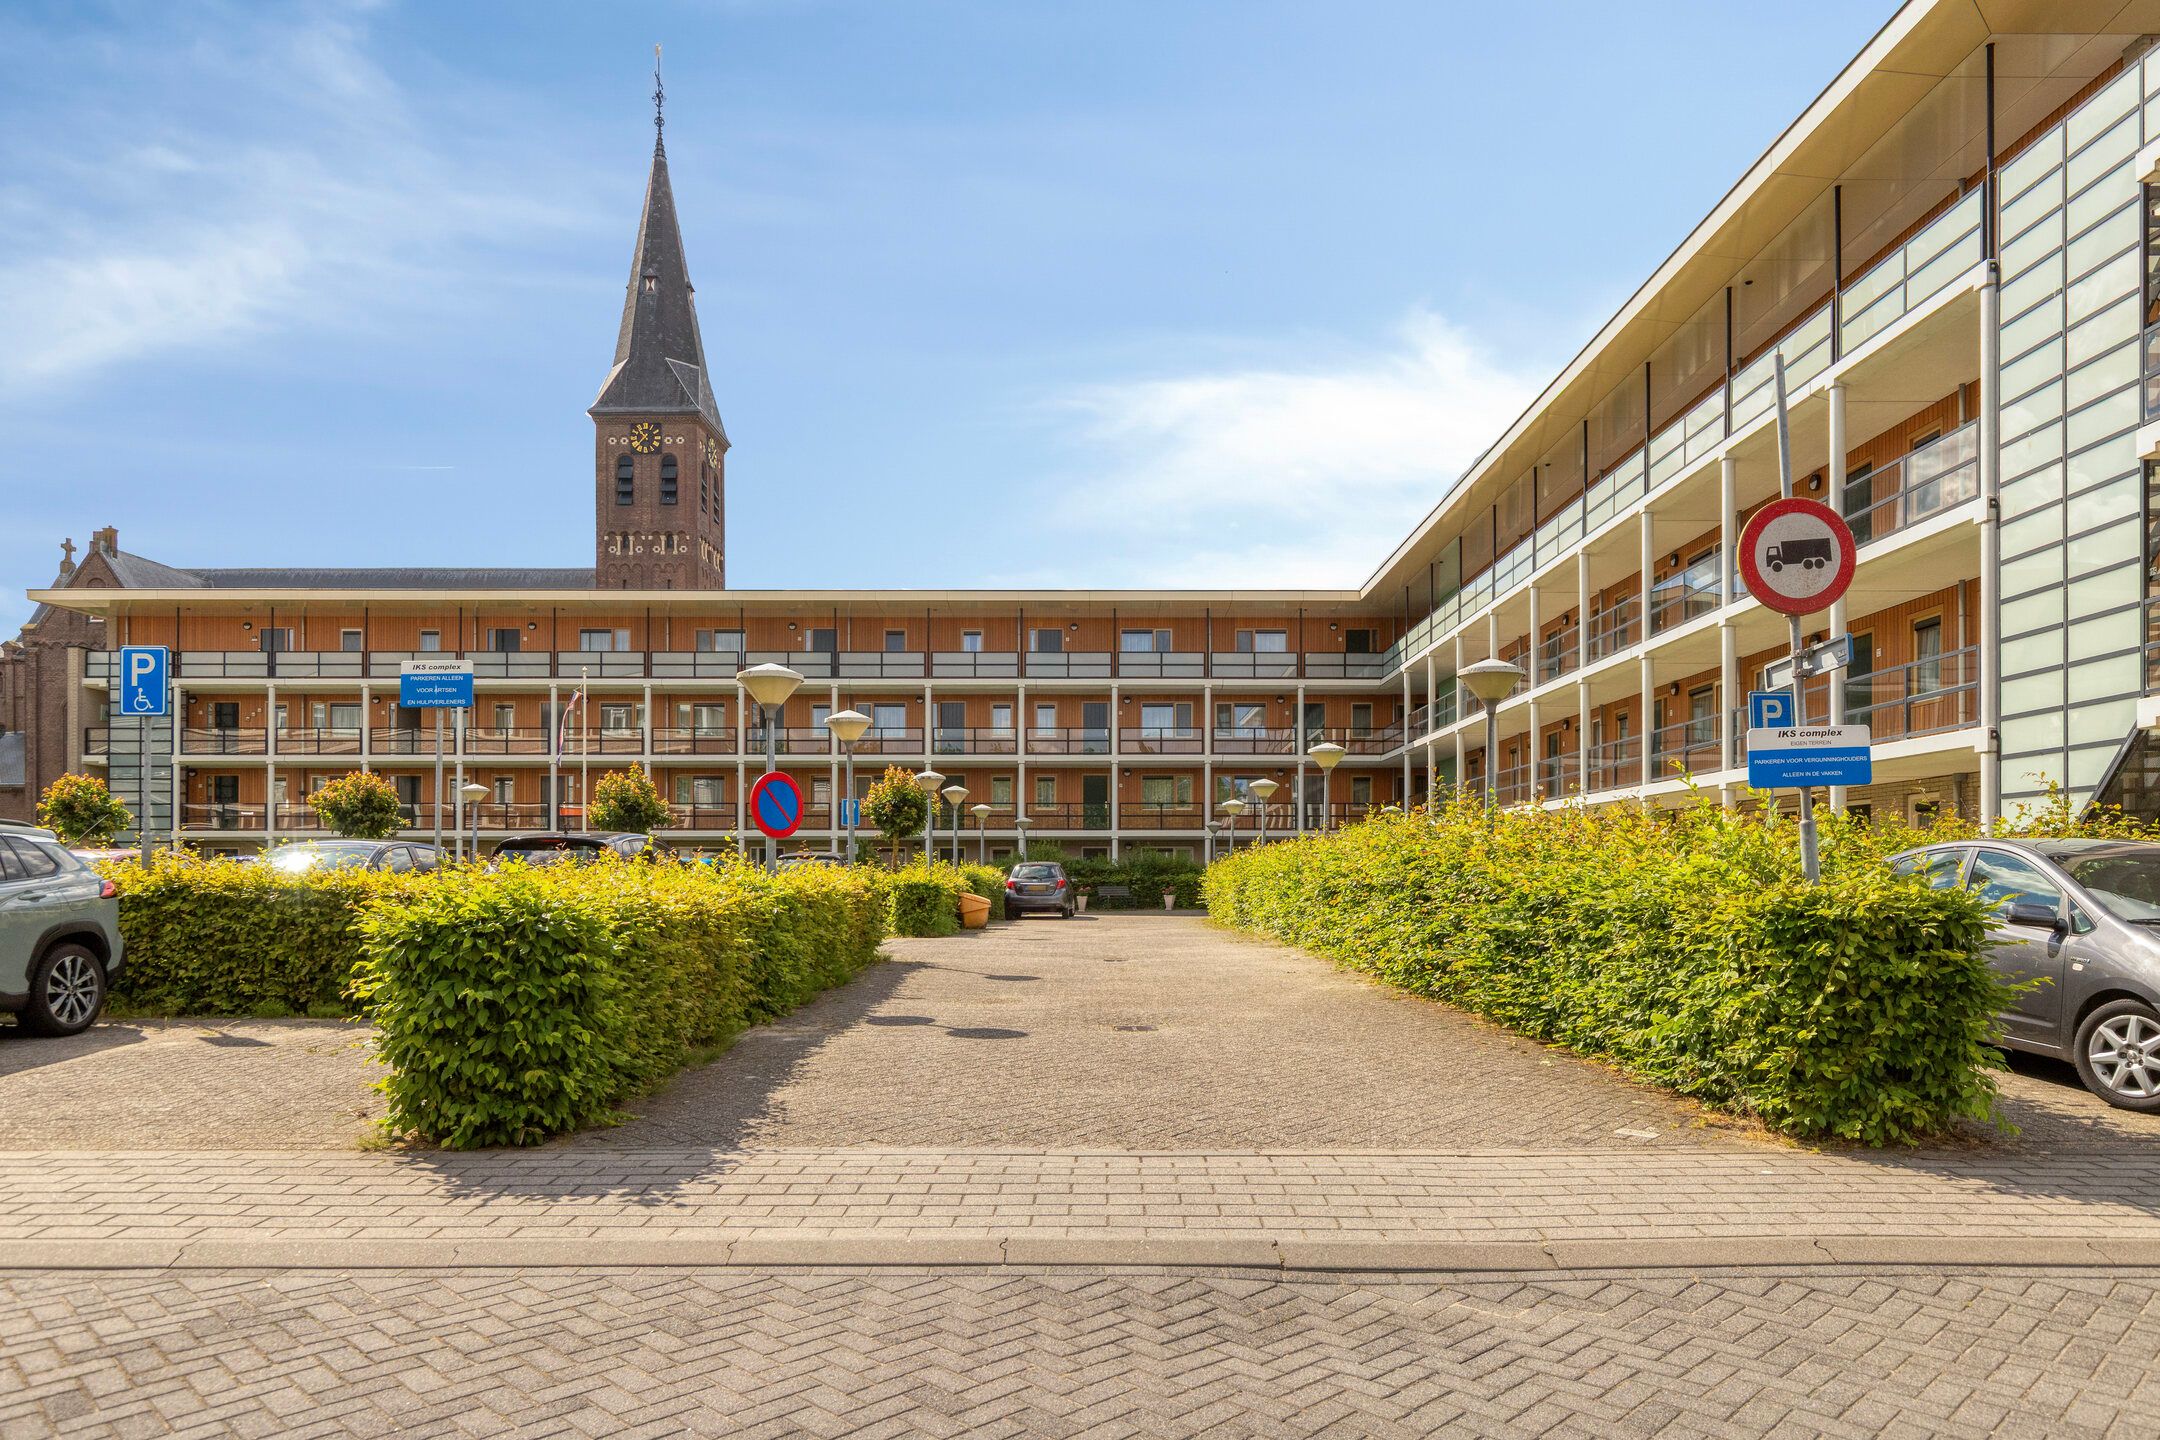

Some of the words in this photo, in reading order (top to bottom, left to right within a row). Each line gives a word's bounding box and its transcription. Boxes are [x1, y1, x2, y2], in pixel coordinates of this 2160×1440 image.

[131, 653, 156, 687] P
[1761, 699, 1783, 728] P
[1778, 730, 1797, 738] IKS
[1799, 729, 1843, 738] complex
